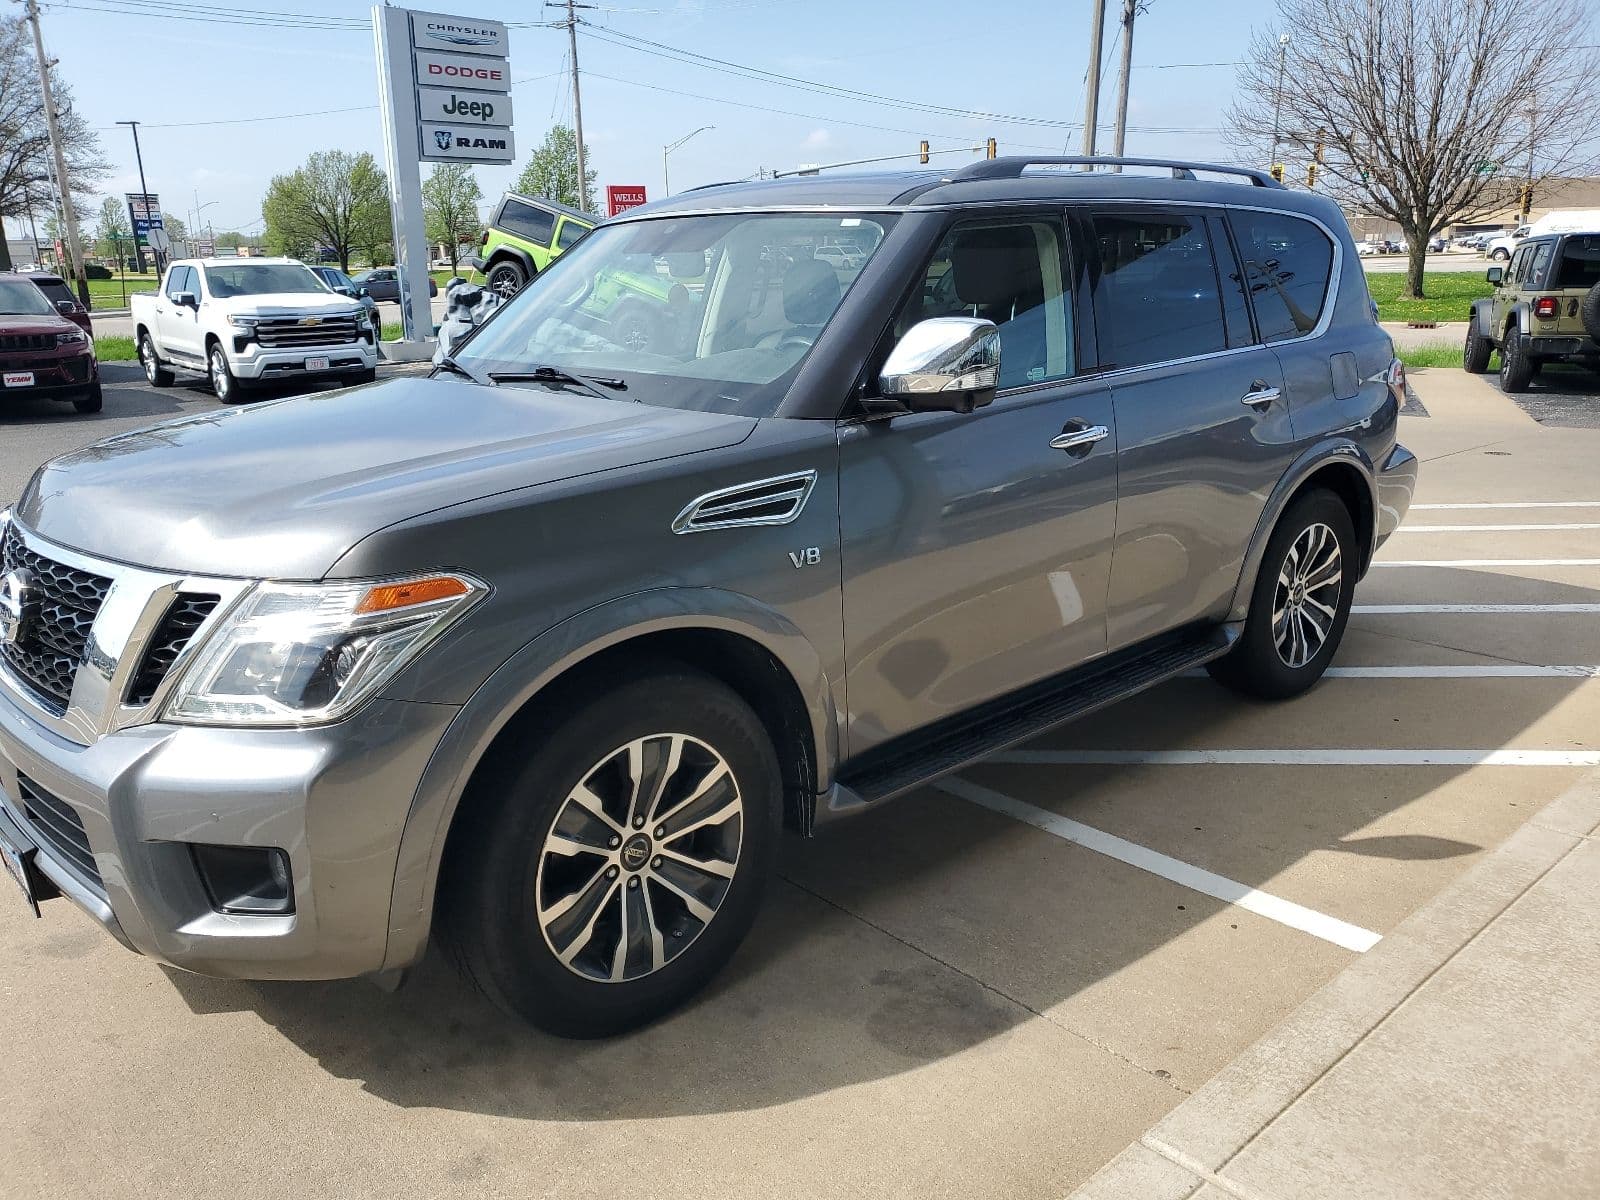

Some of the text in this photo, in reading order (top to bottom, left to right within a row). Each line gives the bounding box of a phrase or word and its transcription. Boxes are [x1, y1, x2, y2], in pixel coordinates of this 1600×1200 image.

[427, 23, 498, 37] CHRYSLER
[428, 63, 502, 81] DODGE
[442, 94, 494, 122] Jeep
[456, 137, 506, 150] RAM
[613, 193, 644, 202] WELLS
[6, 375, 32, 383] YEMM
[788, 546, 821, 569] V8
